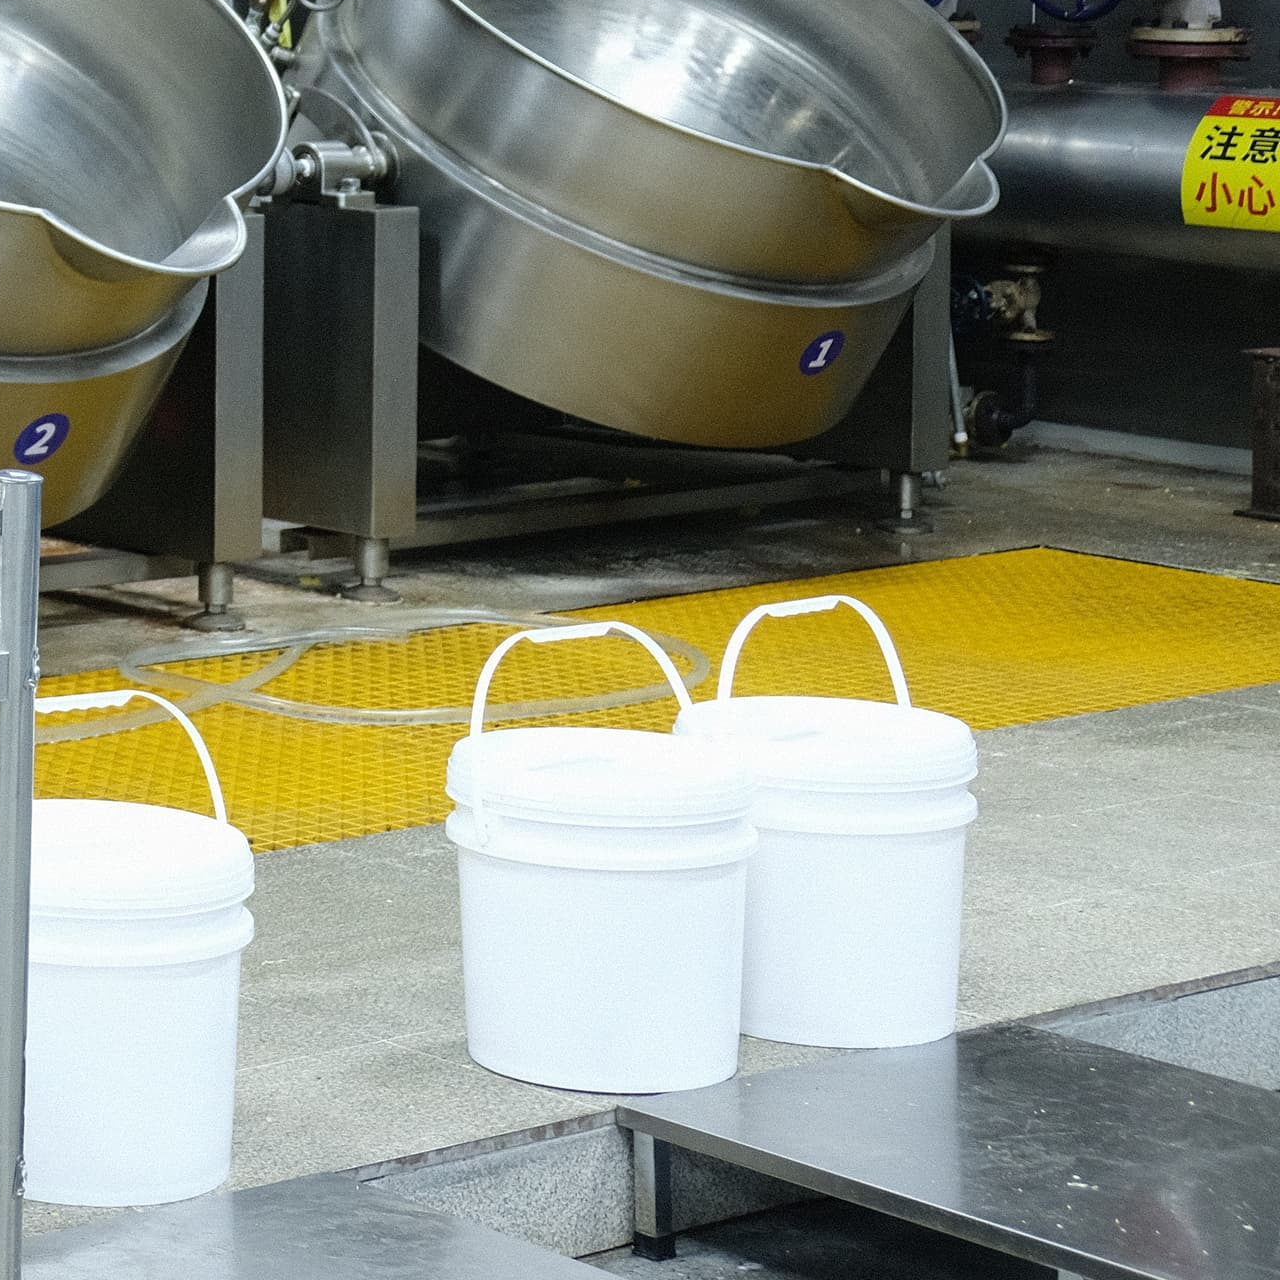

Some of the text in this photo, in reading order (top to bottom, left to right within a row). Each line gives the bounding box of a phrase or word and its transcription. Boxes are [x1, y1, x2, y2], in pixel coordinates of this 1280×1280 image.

[1195, 172, 1276, 215] 小心
[808, 338, 834, 369] 1
[24, 422, 56, 456] 2
